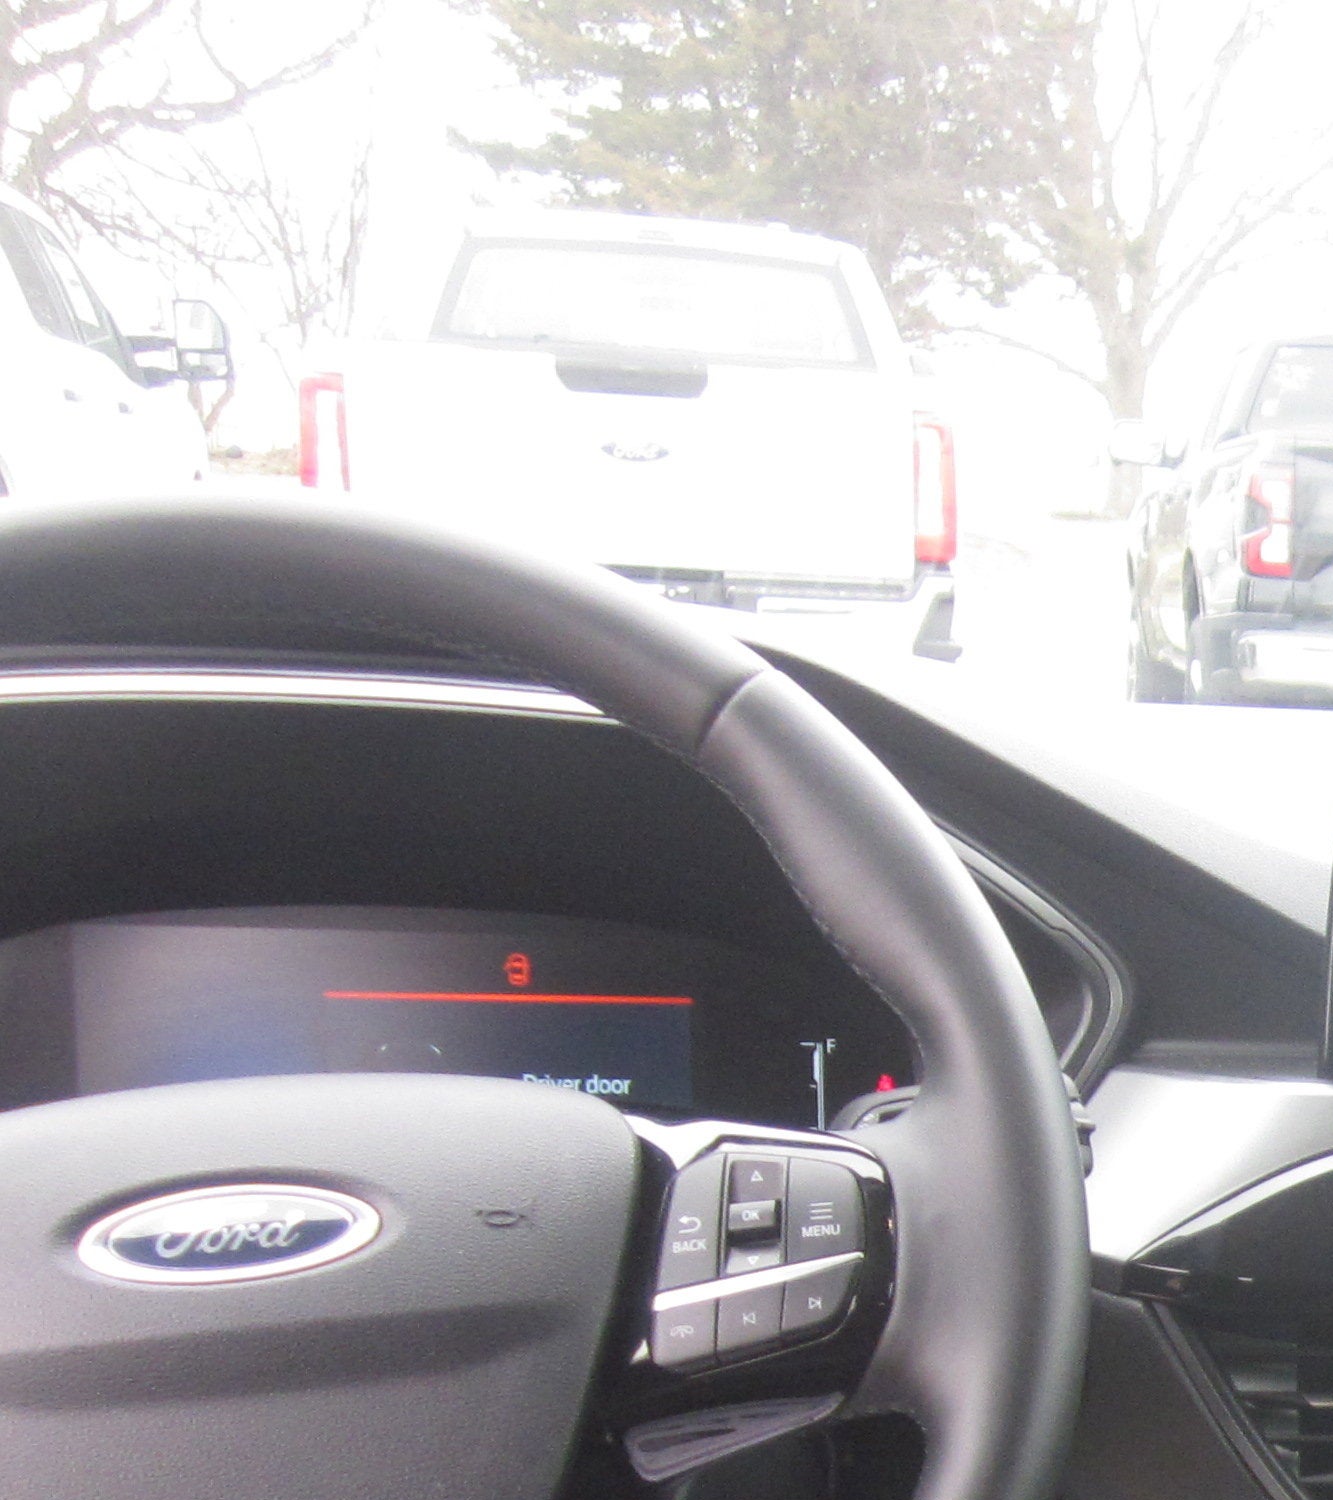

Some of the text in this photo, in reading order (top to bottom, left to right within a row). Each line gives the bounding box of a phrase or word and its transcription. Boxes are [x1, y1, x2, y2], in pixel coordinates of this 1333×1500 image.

[826, 1039, 836, 1054] F
[523, 1074, 631, 1094] iver door
[741, 1210, 760, 1222] OK
[801, 1224, 842, 1238] MENU
[672, 1239, 707, 1254] BACK
